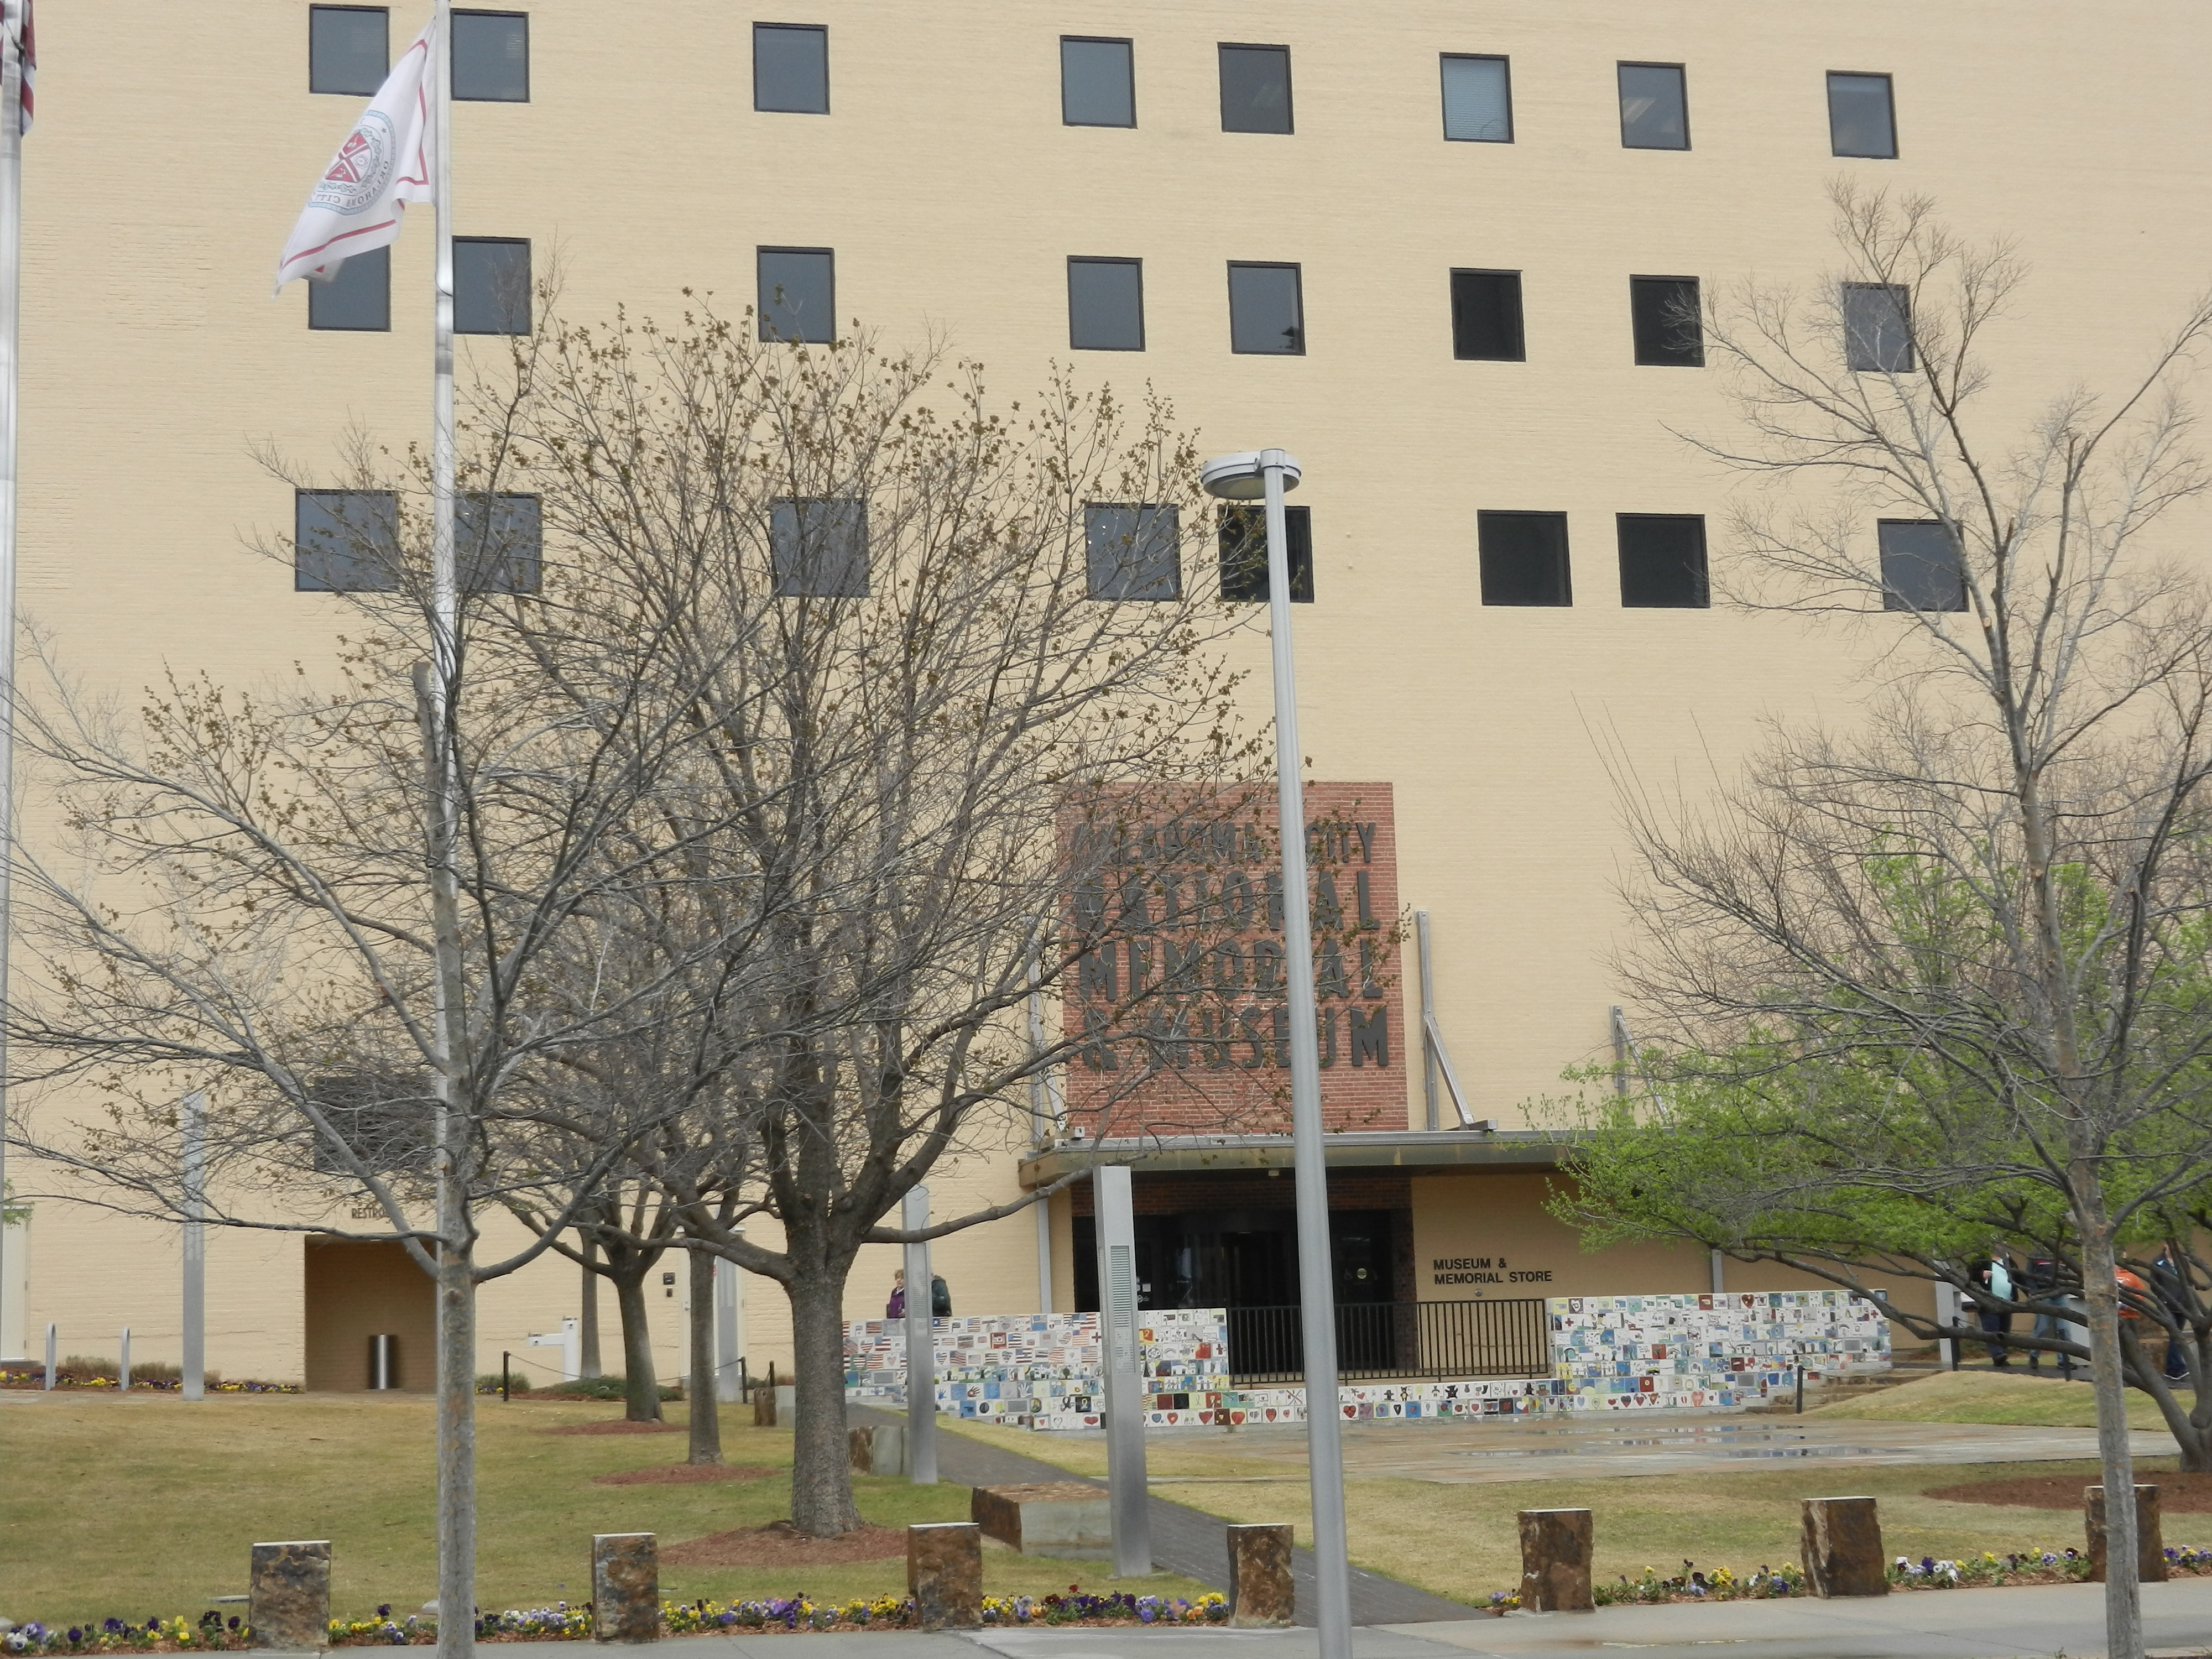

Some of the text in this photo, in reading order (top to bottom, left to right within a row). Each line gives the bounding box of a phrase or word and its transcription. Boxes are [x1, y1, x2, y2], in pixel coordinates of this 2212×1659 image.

[1303, 822, 1376, 863] CITY
[1078, 938, 1383, 1001] MEMORAL
[351, 1207, 386, 1219] RESTRO
[1433, 1258, 1507, 1270] MUSEUM &
[1434, 1271, 1552, 1285] MEMORIAL STORE
